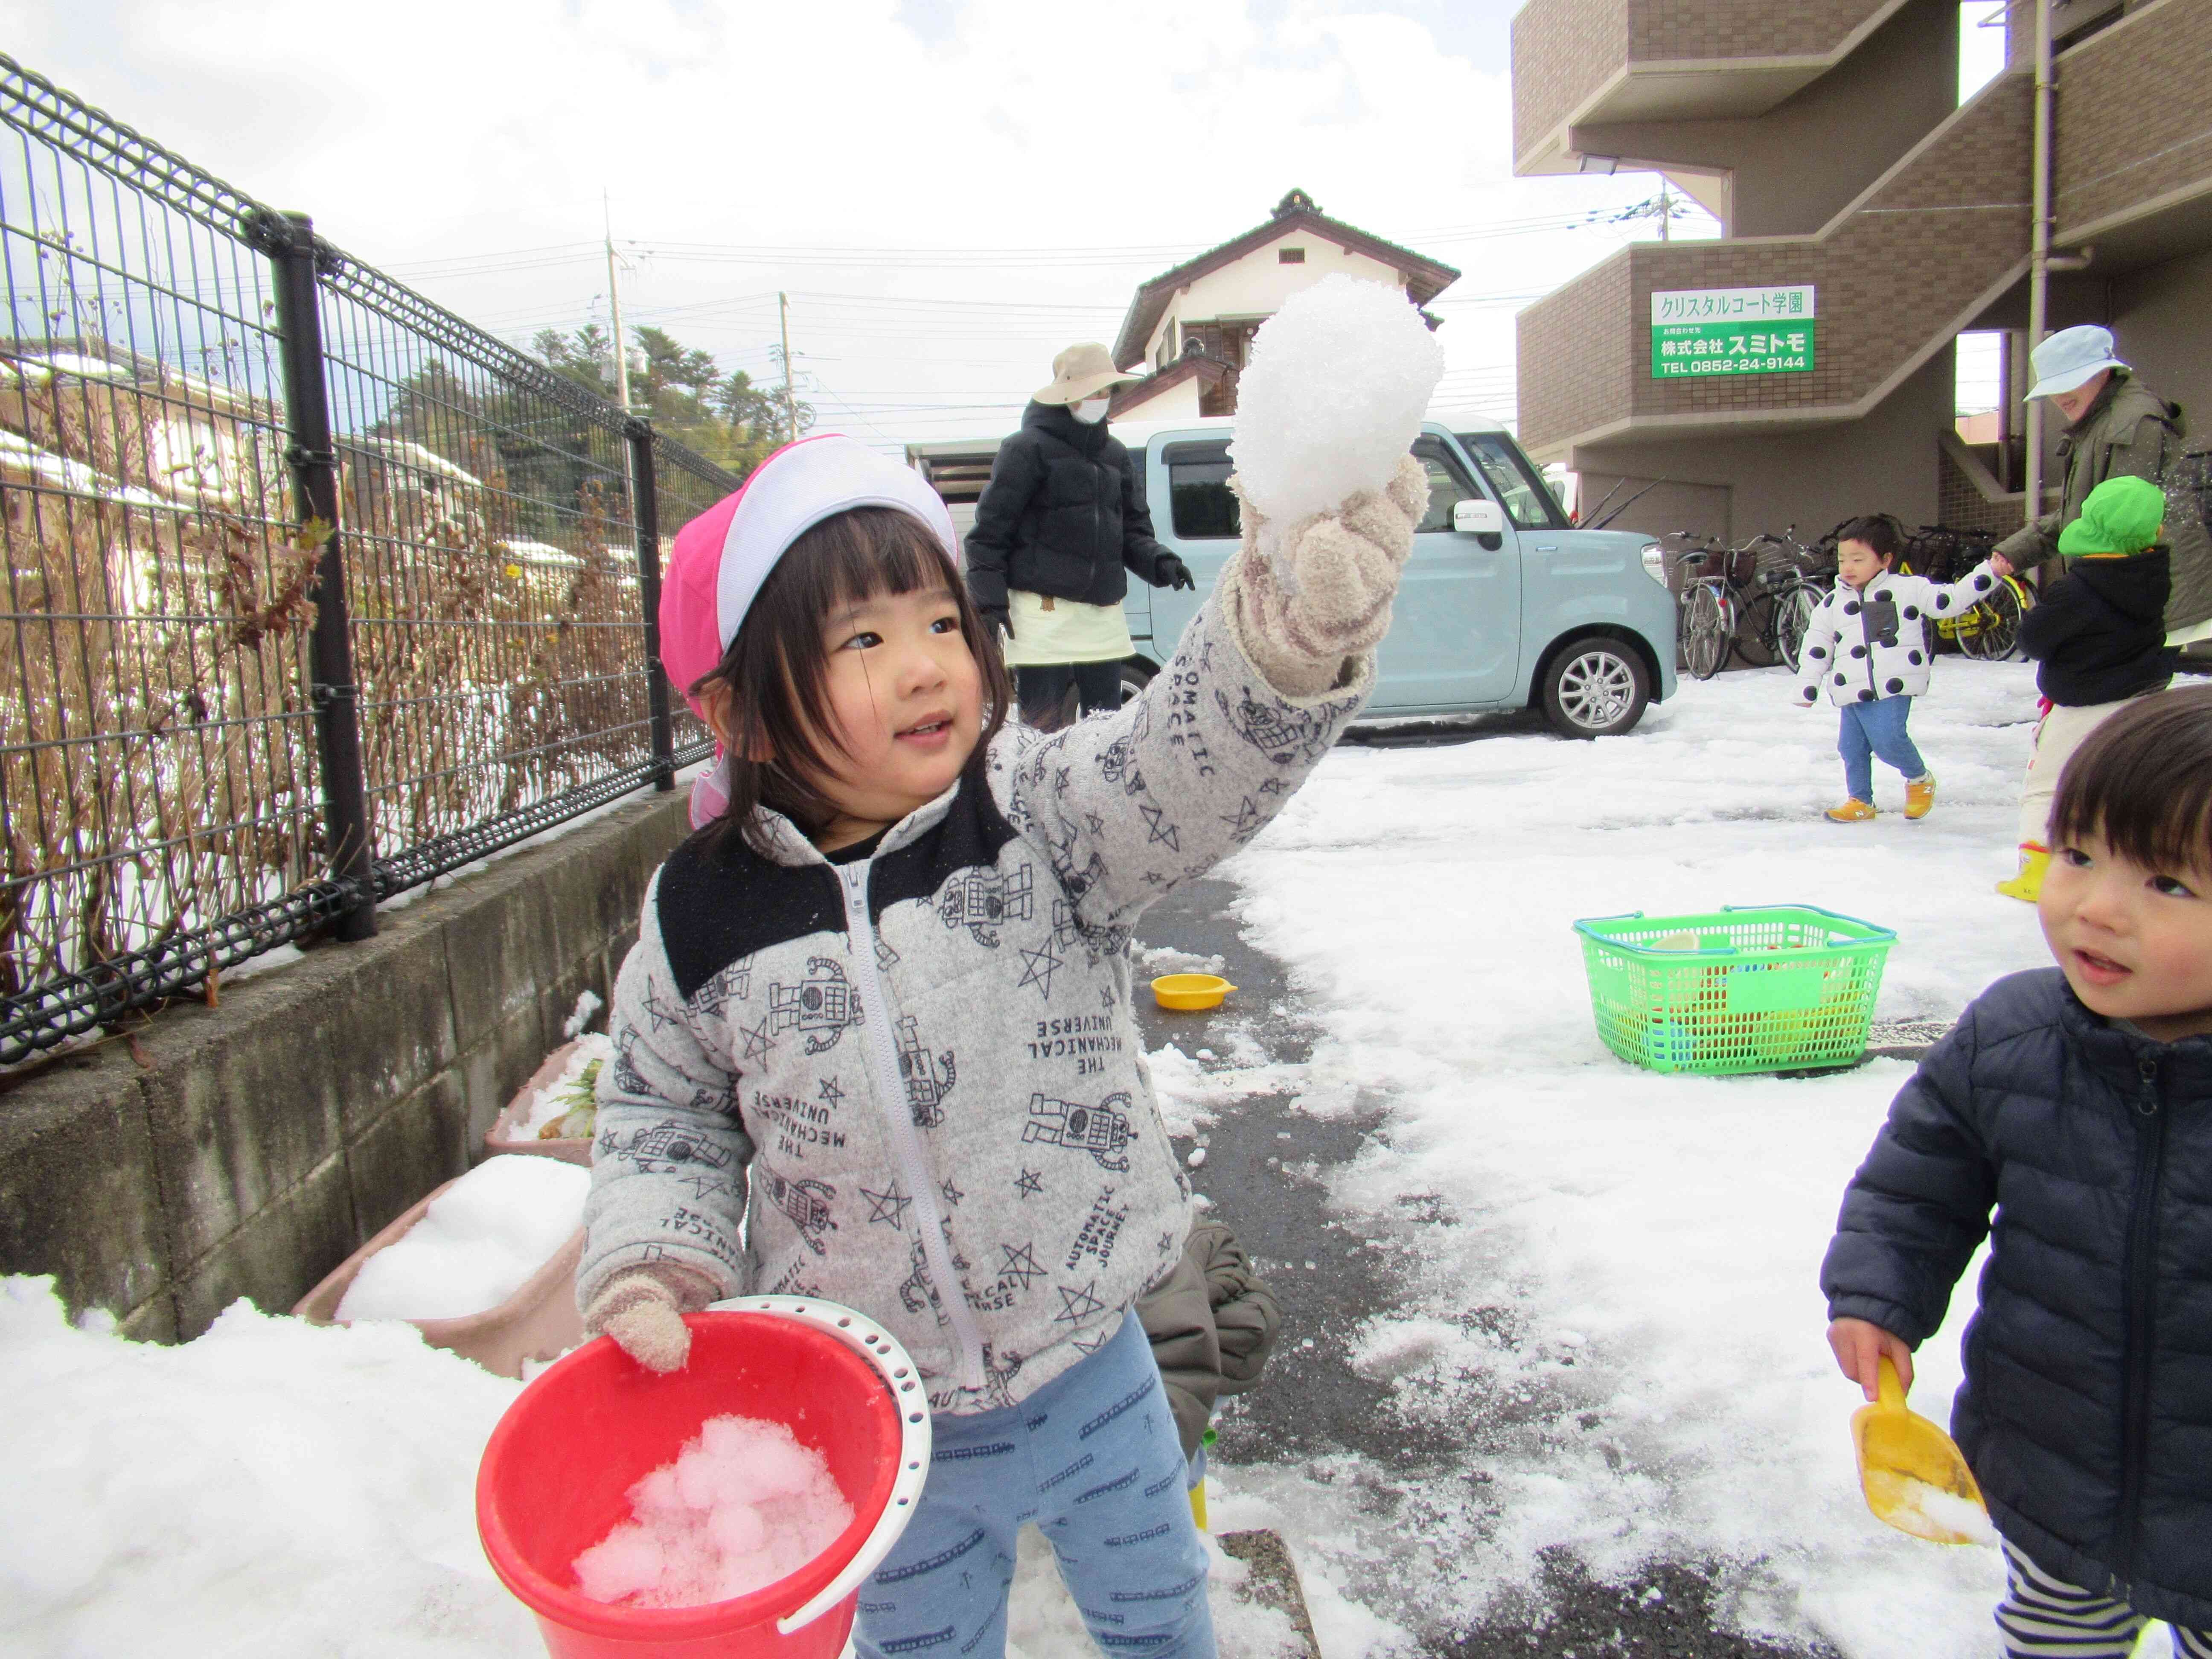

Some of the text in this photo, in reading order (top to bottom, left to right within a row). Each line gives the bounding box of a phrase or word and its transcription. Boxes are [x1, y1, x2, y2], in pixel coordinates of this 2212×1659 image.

[1661, 291, 1803, 318] クリスタルコート学園
[1661, 356, 1805, 374] TEL 0852-24-9144
[1037, 1015, 1112, 1038] UNIVERSE
[1027, 1036, 1122, 1059] MECHANICAL
[1077, 1057, 1105, 1076] THE
[754, 1091, 829, 1125] UNIVERSE
[750, 1106, 846, 1148] MECHANICAL
[778, 1135, 803, 1158] THE
[1065, 1185, 1115, 1270] AUTOMATIC
[1086, 1208, 1116, 1255] SPACE
[1097, 1203, 1130, 1268] JOURNEY
